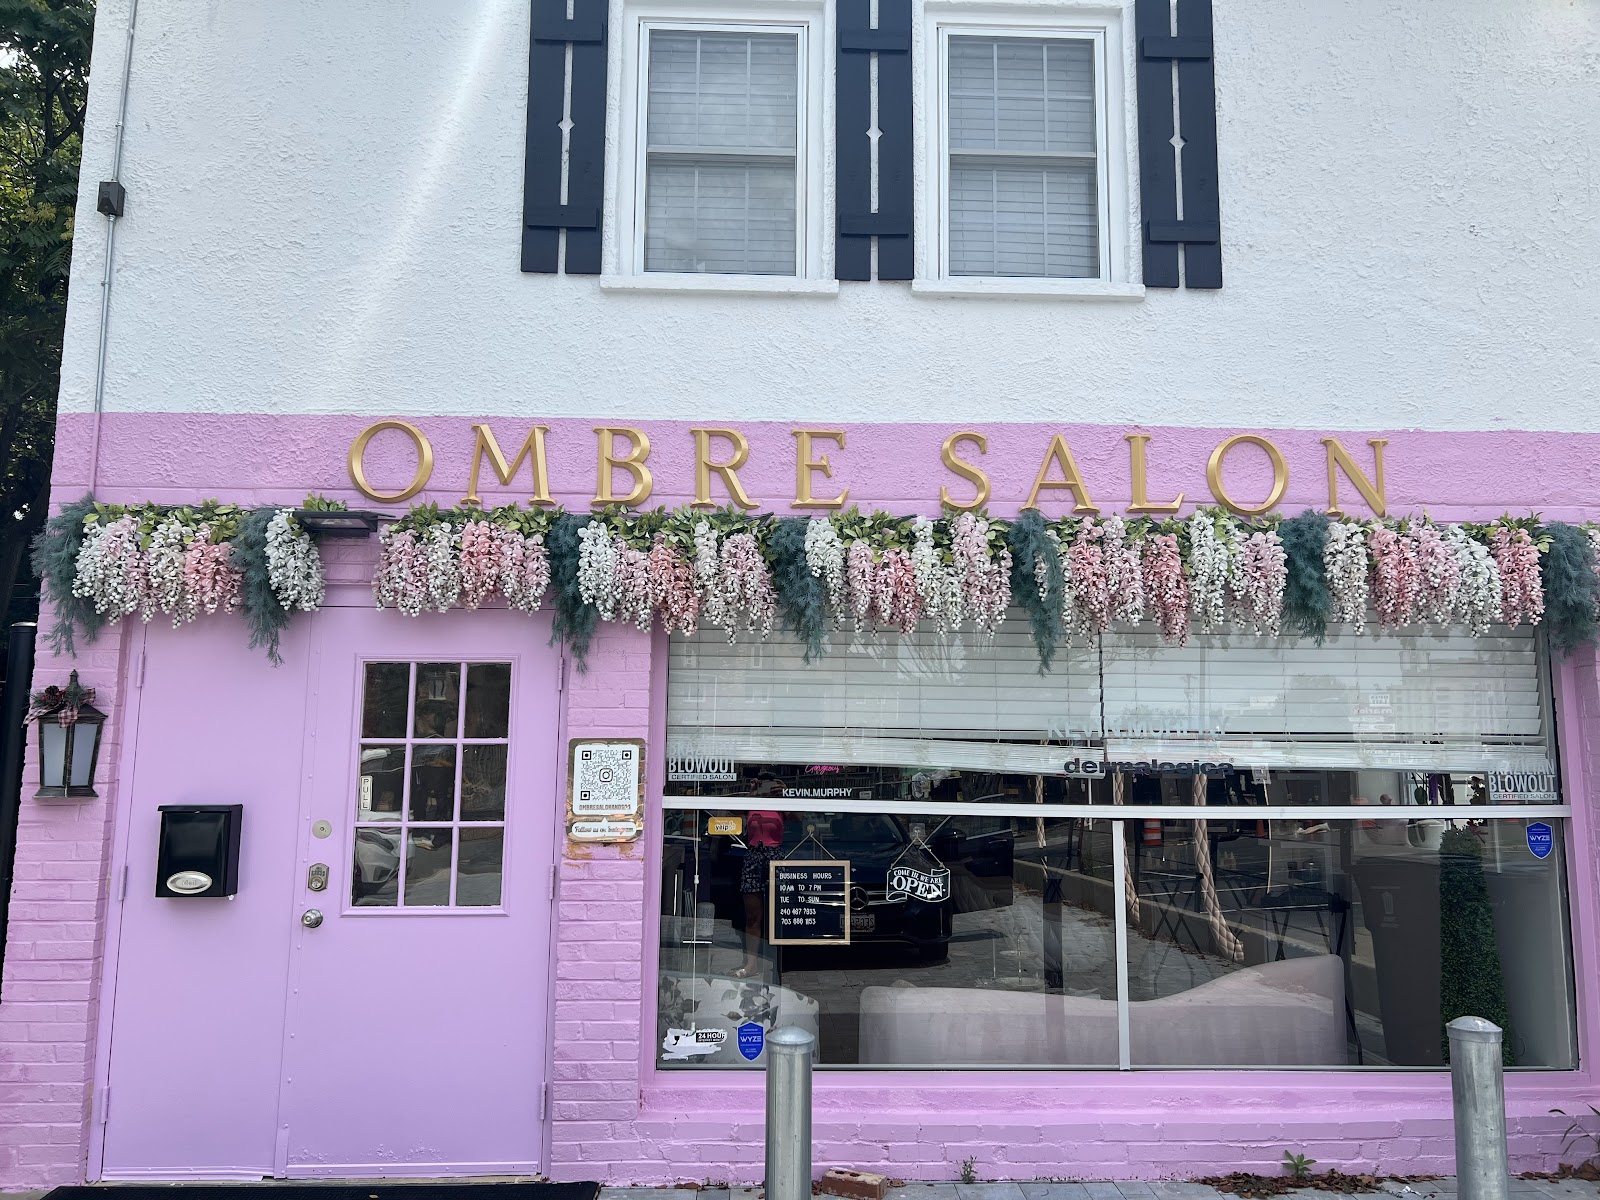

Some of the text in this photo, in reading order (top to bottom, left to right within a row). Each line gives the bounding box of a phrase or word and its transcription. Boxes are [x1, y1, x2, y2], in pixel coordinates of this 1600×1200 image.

[348, 420, 1390, 518] OMBRE SALON
[669, 756, 735, 773] BLOWOUT
[1063, 758, 1235, 776] dermalogica
[782, 787, 852, 797] KEVIN.MURPHY
[1488, 775, 1556, 792] BLOWOUT
[362, 778, 370, 809] PULL
[779, 872, 808, 880] BUSINESS
[920, 875, 929, 883] WE
[892, 875, 944, 898] OPEN
[739, 1035, 762, 1043] WYZE
